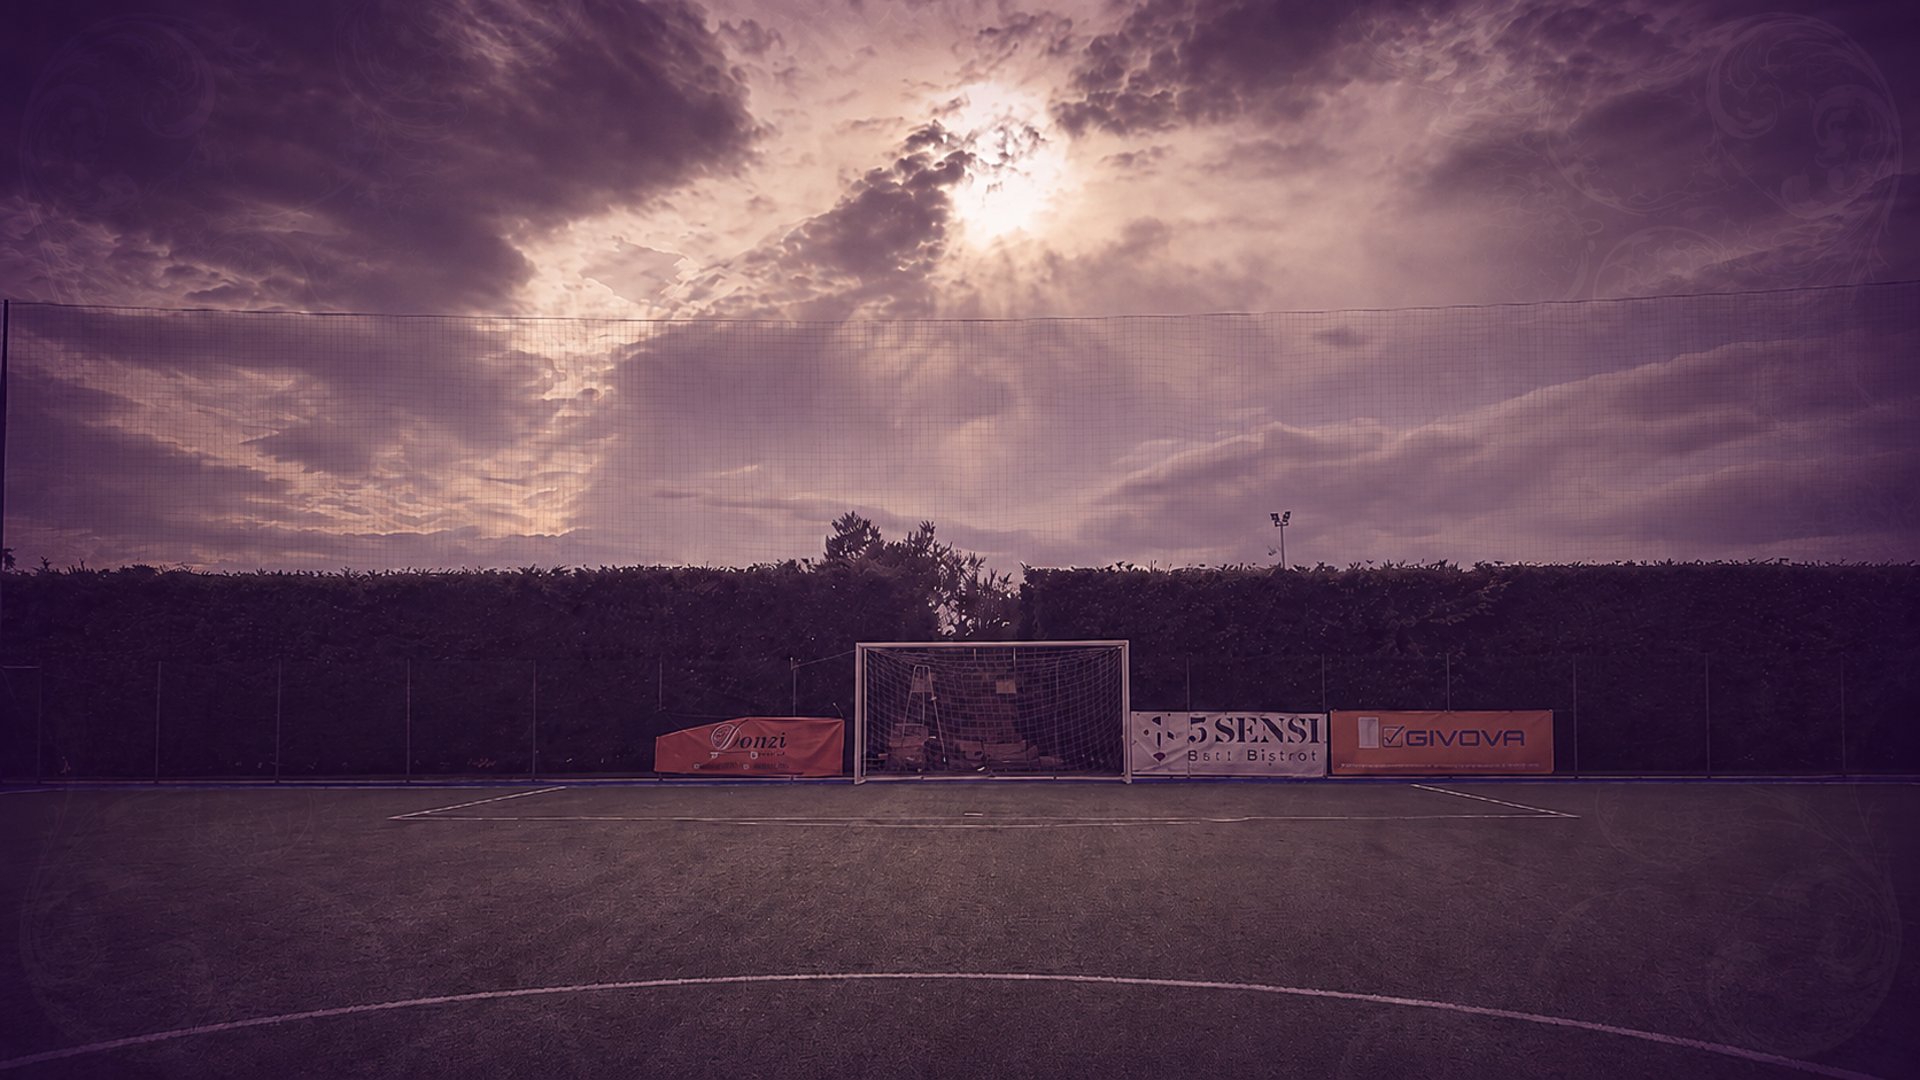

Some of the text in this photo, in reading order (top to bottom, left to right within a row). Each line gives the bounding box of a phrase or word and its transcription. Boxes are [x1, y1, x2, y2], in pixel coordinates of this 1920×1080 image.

[1190, 717, 1320, 743] 5 SENSI
[1406, 730, 1524, 746] GIVOVA
[1247, 749, 1317, 762] Bistrot
